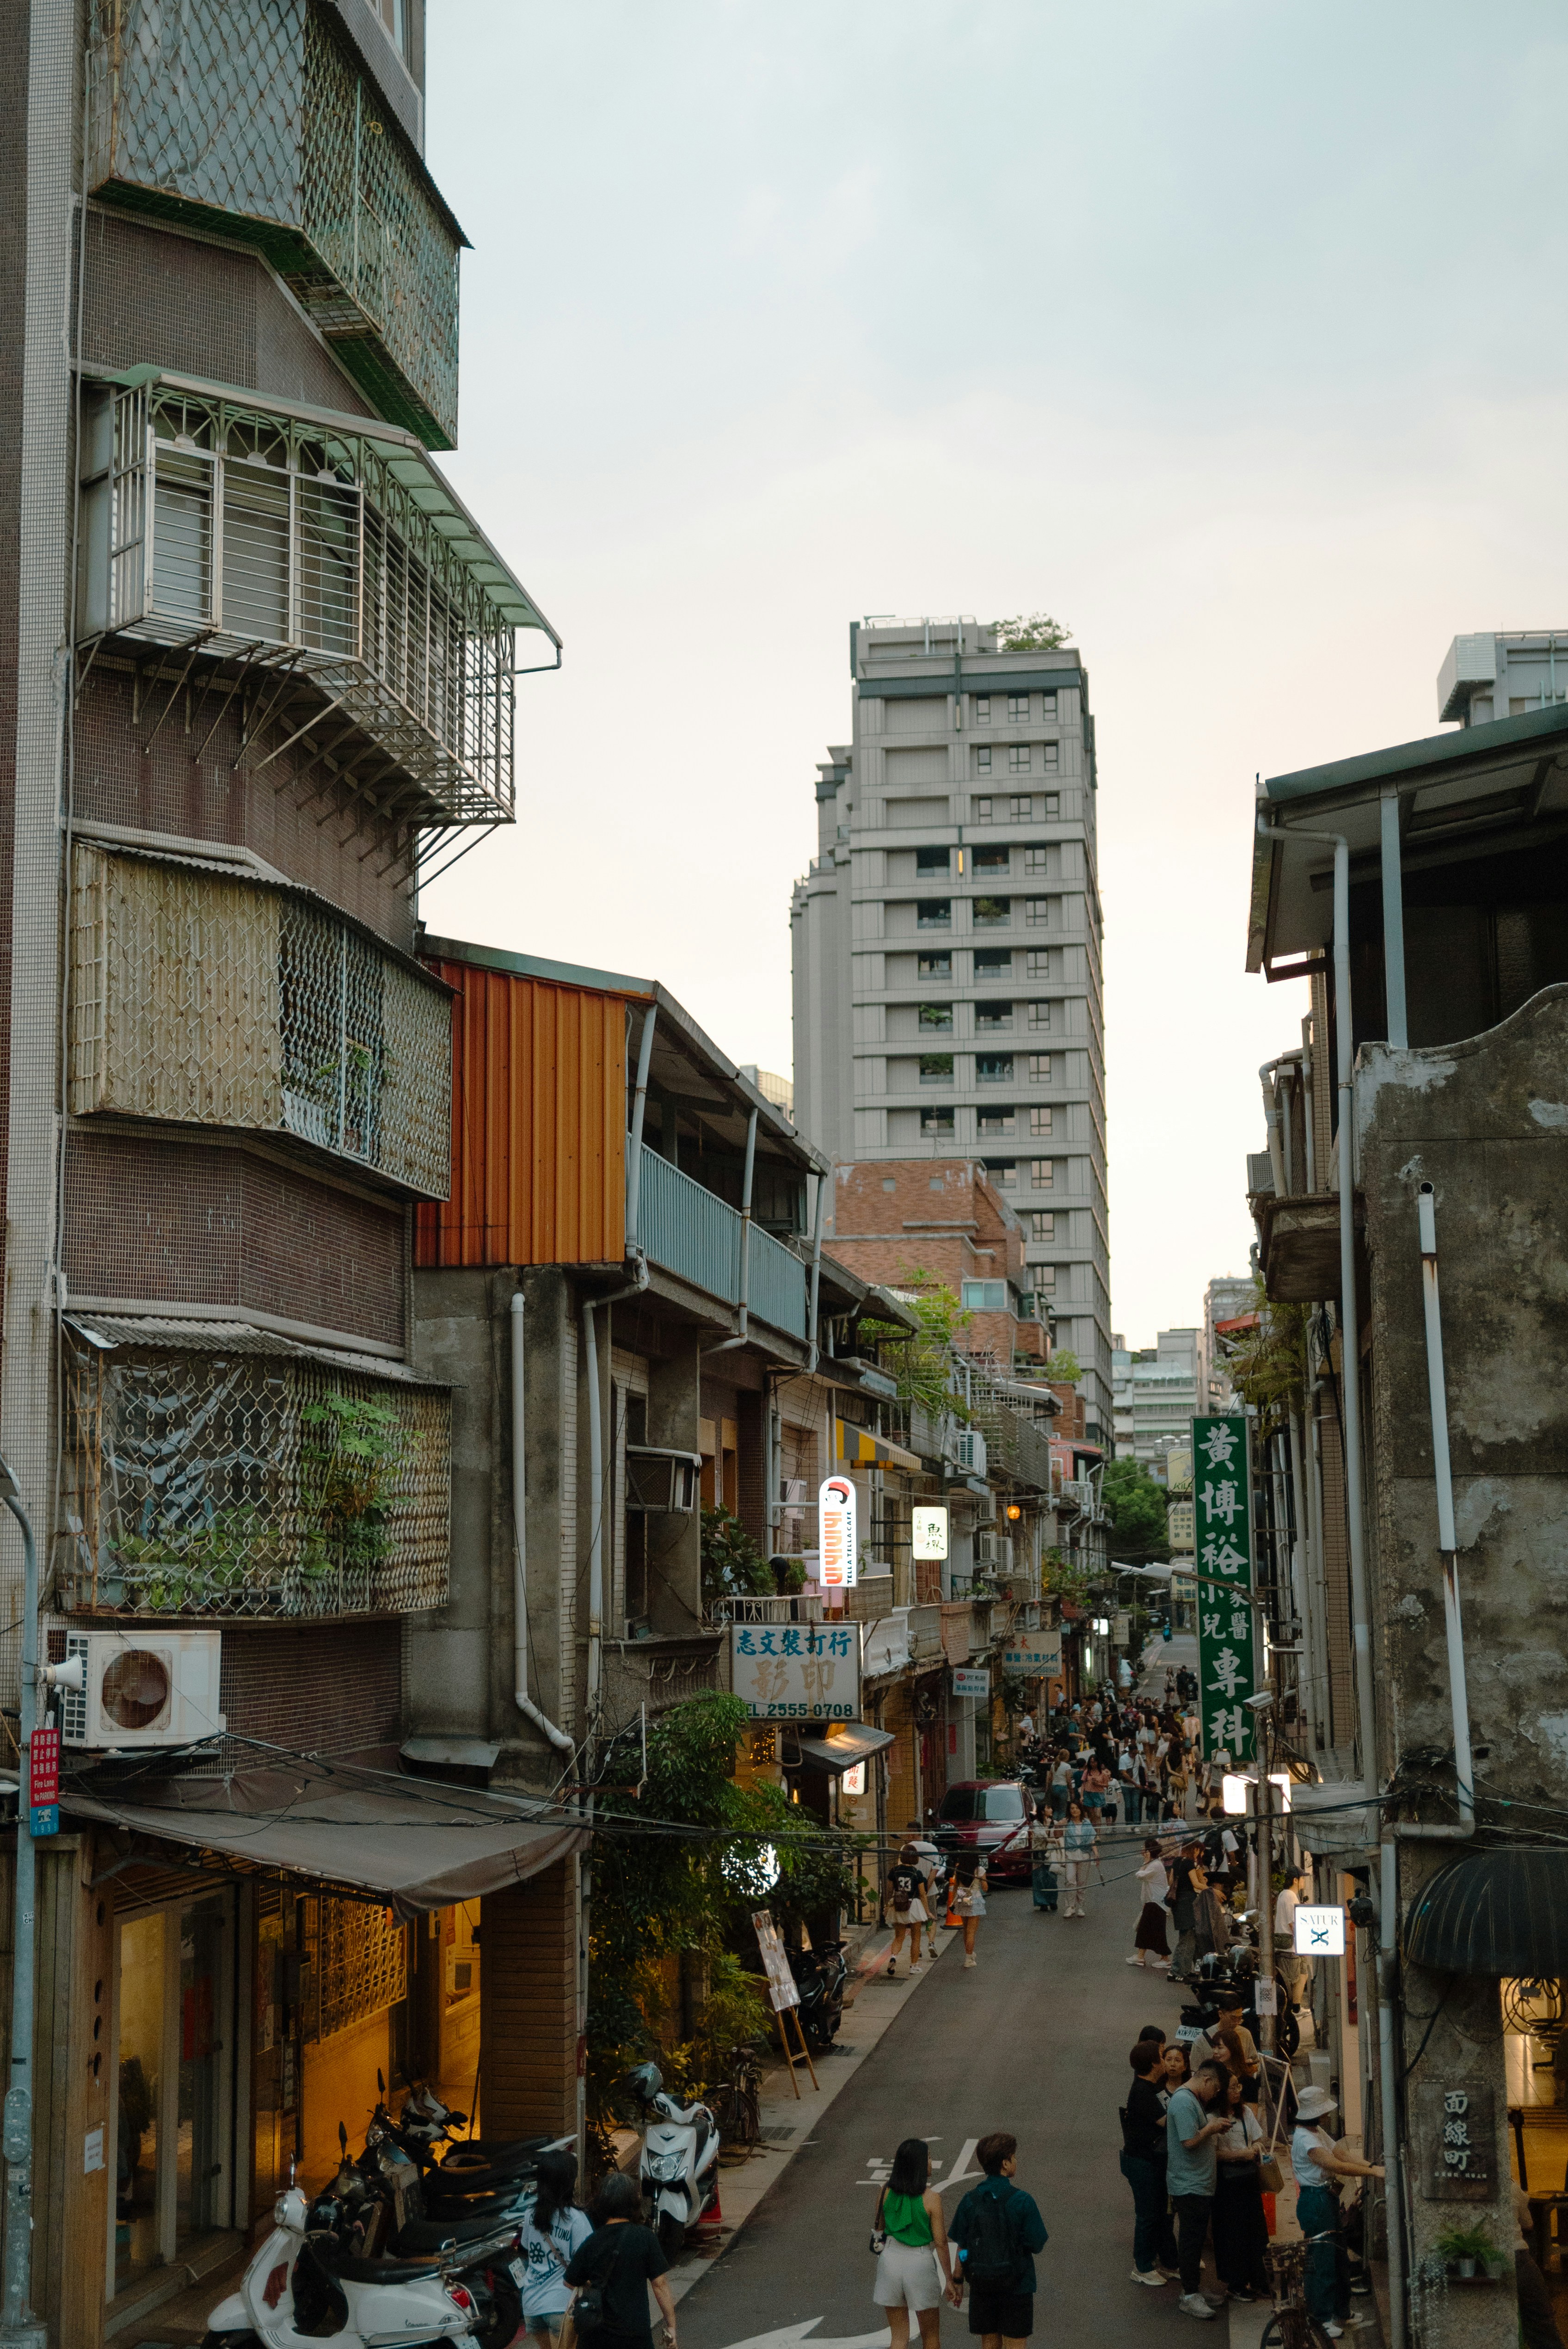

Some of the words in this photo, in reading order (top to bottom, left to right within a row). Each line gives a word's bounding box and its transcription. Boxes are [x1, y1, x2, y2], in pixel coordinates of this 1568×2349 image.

[736, 1630, 852, 1657] 志文裝訂行
[750, 1659, 836, 1701] 影印
[813, 1703, 853, 1717] 0708
[33, 1734, 57, 1746] 消防通道
[33, 1747, 57, 1760] 禁止停車
[33, 1761, 56, 1775] 加強拖吊
[34, 1780, 43, 1789] Fire
[40, 1791, 55, 1800] PARKING
[34, 1823, 57, 1834] 1999
[1443, 2089, 1472, 2171] 面線町
